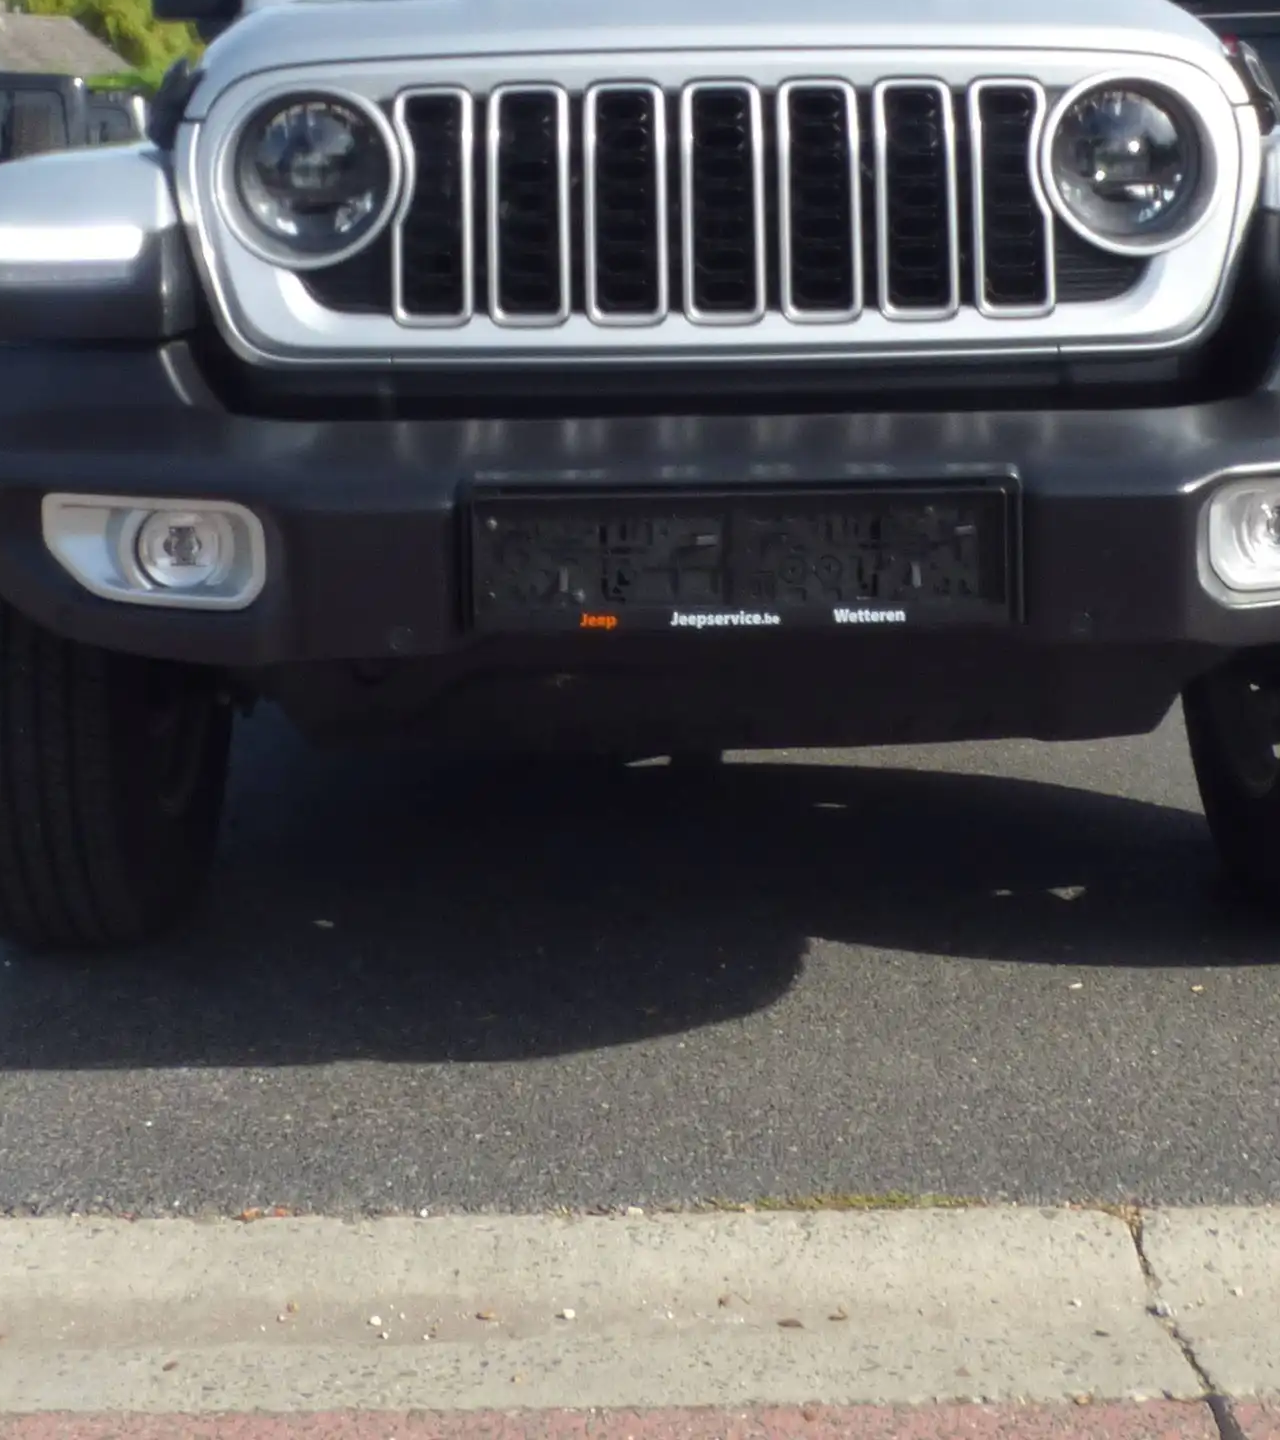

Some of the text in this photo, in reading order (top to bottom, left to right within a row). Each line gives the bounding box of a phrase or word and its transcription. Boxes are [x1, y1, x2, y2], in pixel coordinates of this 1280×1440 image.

[580, 612, 618, 630] Jeep
[670, 611, 780, 629] Jeepservice.be
[833, 608, 906, 624] Wetteren
